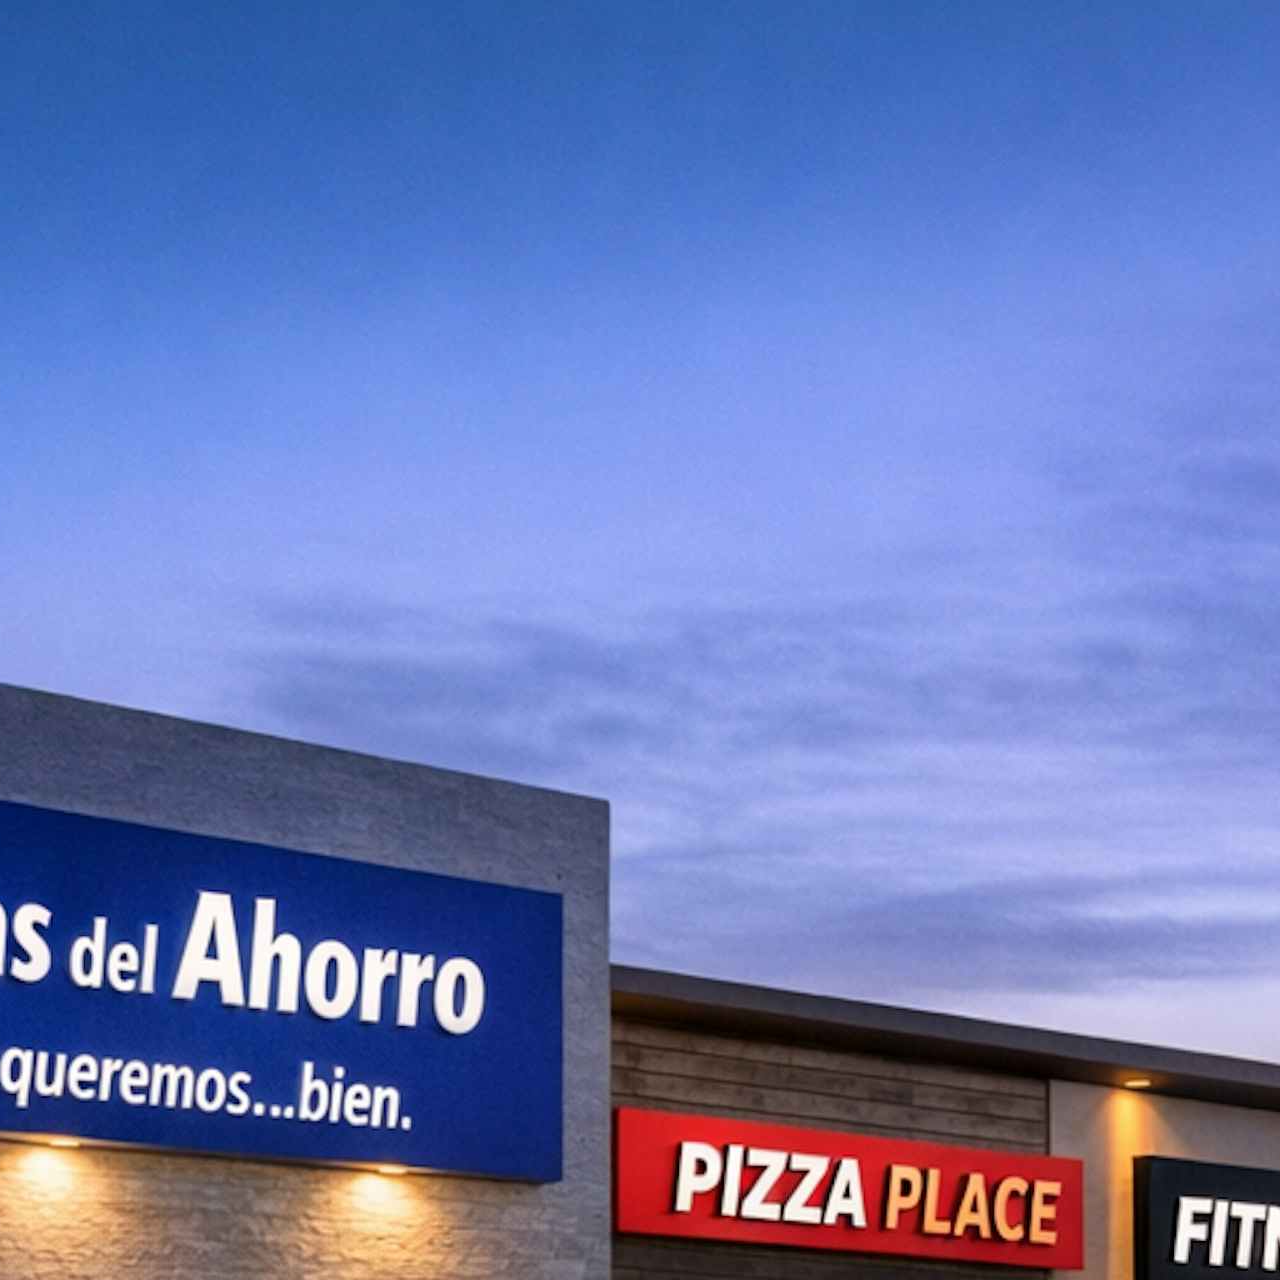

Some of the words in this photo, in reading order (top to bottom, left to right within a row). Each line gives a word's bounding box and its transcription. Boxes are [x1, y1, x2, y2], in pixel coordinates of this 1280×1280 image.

[69, 916, 159, 994] del
[173, 891, 485, 1035] Ahorro
[674, 1141, 867, 1228] PIZZA
[885, 1164, 1062, 1244] PLACE
